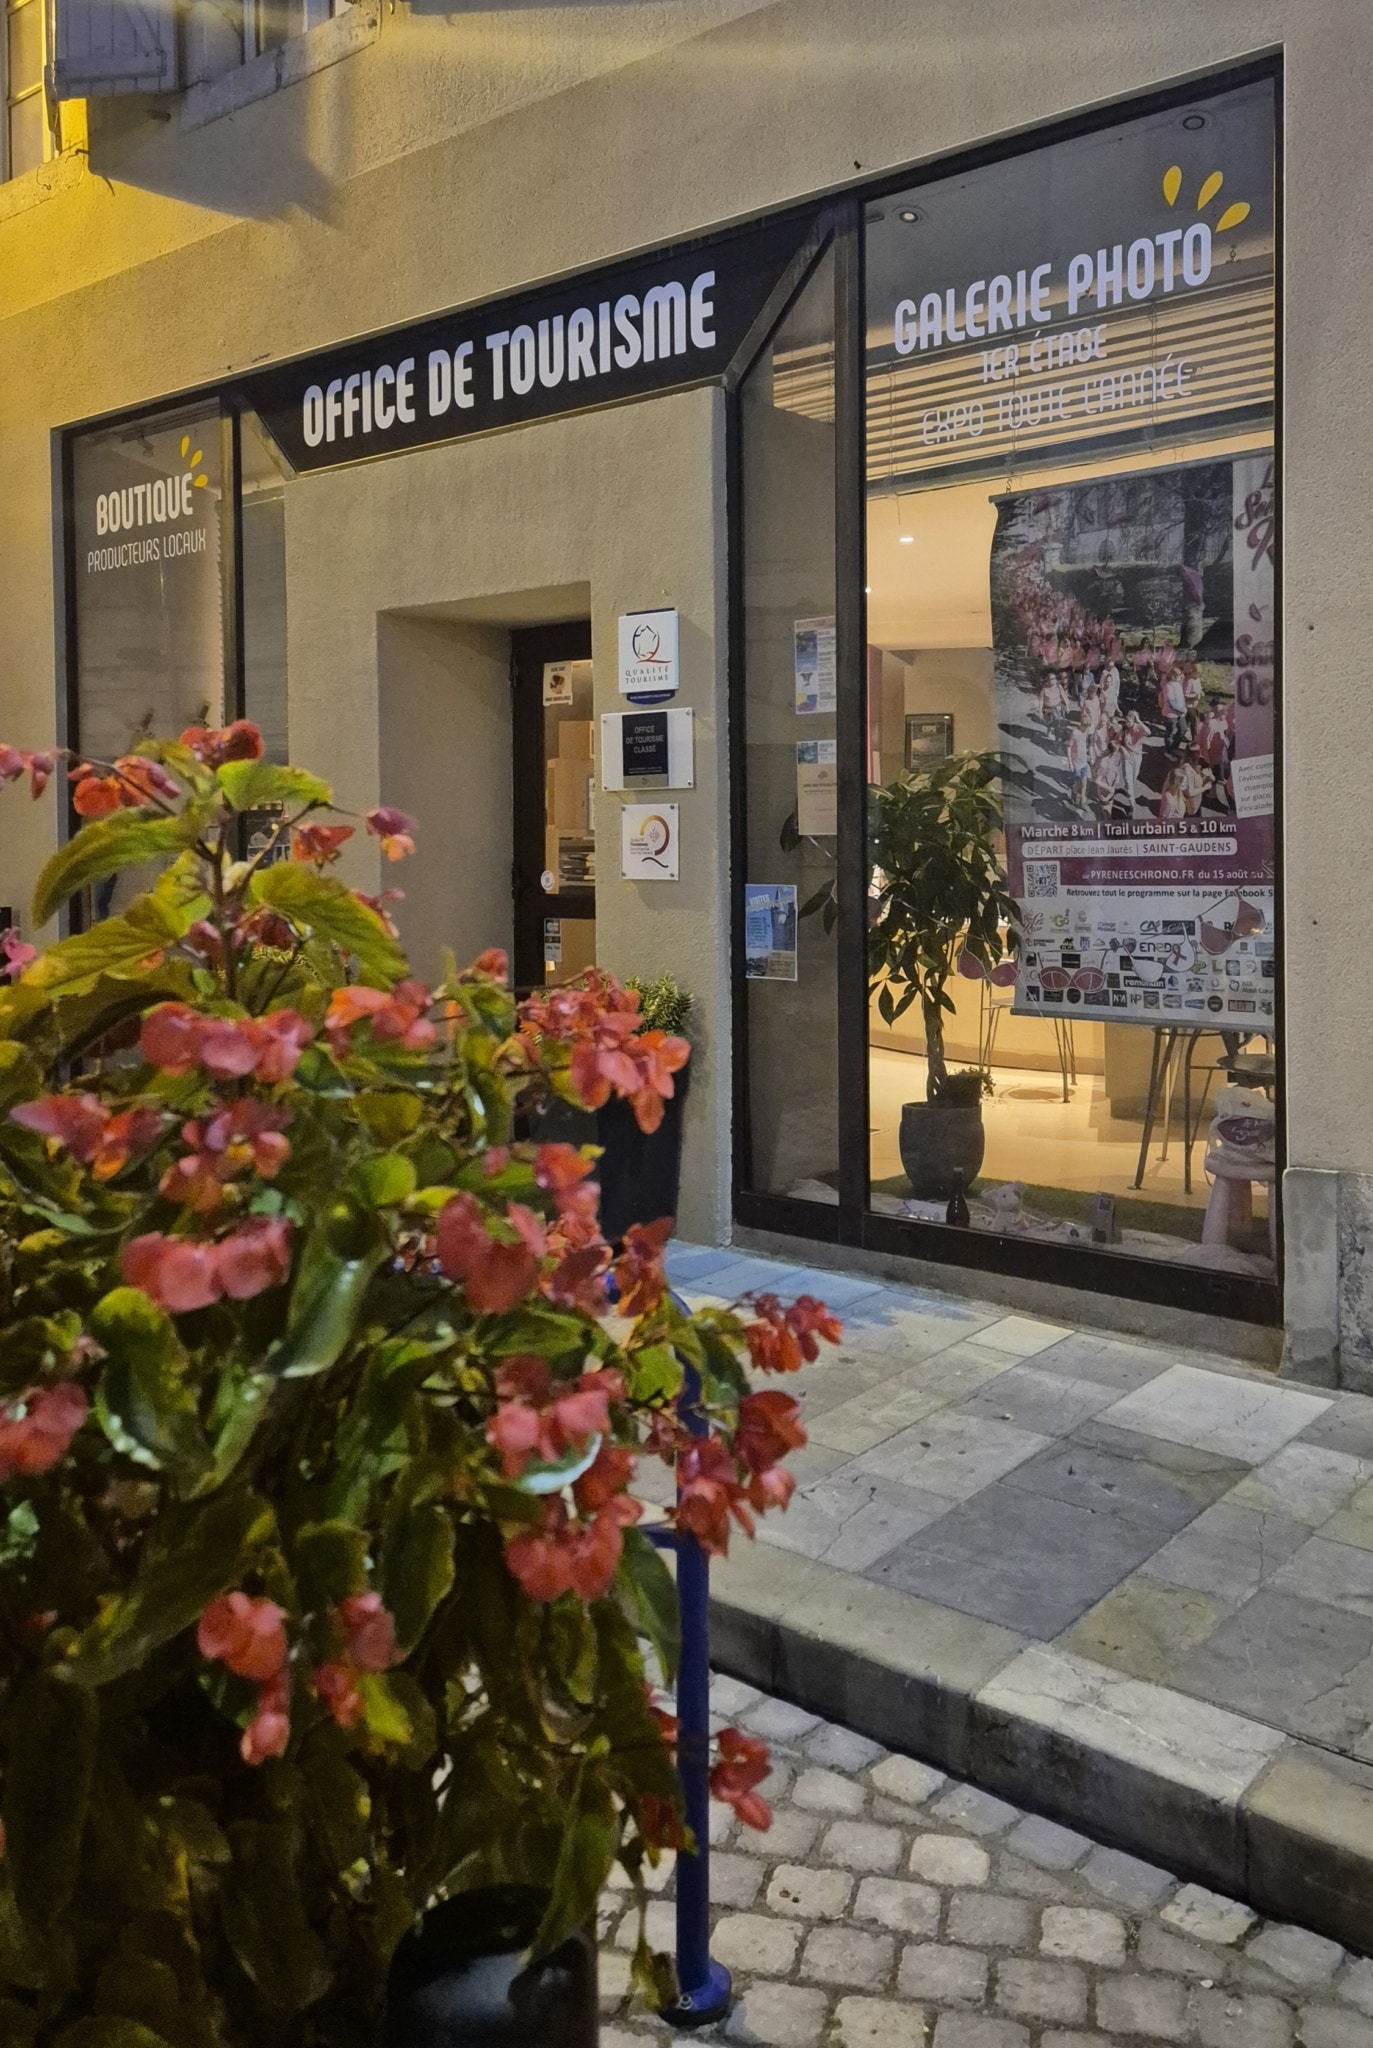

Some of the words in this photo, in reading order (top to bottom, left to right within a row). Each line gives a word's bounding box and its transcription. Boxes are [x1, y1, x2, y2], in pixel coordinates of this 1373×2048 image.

[894, 262, 1052, 355] GALERIE
[1067, 222, 1213, 316] PHOTO
[302, 356, 416, 448] OFFICE
[428, 340, 475, 417] DE
[486, 270, 717, 401] TOURISME
[980, 342, 1020, 384] 1ER
[1029, 323, 1109, 374] ÉTAGE
[921, 401, 985, 446] EXPO
[997, 375, 1073, 432] TOUTE
[1084, 352, 1193, 415] L'ANNÉE
[96, 472, 194, 536] BOUTIQUE
[87, 537, 161, 573] PRODUCTEURS
[163, 527, 206, 558] LOCAUX
[625, 665, 669, 677] QUALITÉ
[625, 674, 669, 684] TOURISME
[634, 725, 655, 734] OFFICE
[625, 737, 634, 745] DE
[635, 734, 665, 744] TOURISME
[633, 745, 657, 754] CLASSÉ
[1021, 825, 1069, 838] Marche
[1071, 824, 1078, 836] 8
[1080, 826, 1094, 836] km
[1104, 822, 1129, 835] Trail
[1132, 821, 1175, 835] urbain
[1178, 821, 1187, 834] 5
[1190, 824, 1198, 833] &
[1201, 820, 1217, 833] 10
[1219, 822, 1237, 833] km
[1027, 843, 1063, 855] DÉPART
[1066, 844, 1085, 857] place
[1107, 844, 1133, 854] Jaurès
[1142, 841, 1232, 854] SAINT-GAUDENS
[1090, 869, 1195, 880] PYRENEESCHRONO.FR
[1198, 869, 1210, 879] du
[1212, 869, 1224, 879] 15
[1226, 868, 1248, 879] août
[1066, 888, 1100, 897] Retrouvez
[1102, 889, 1117, 897] tout
[1118, 888, 1126, 897] le
[1127, 889, 1174, 899] programme
[1177, 889, 1191, 897] sur
[1192, 888, 1200, 897] la
[1202, 889, 1222, 899] page
